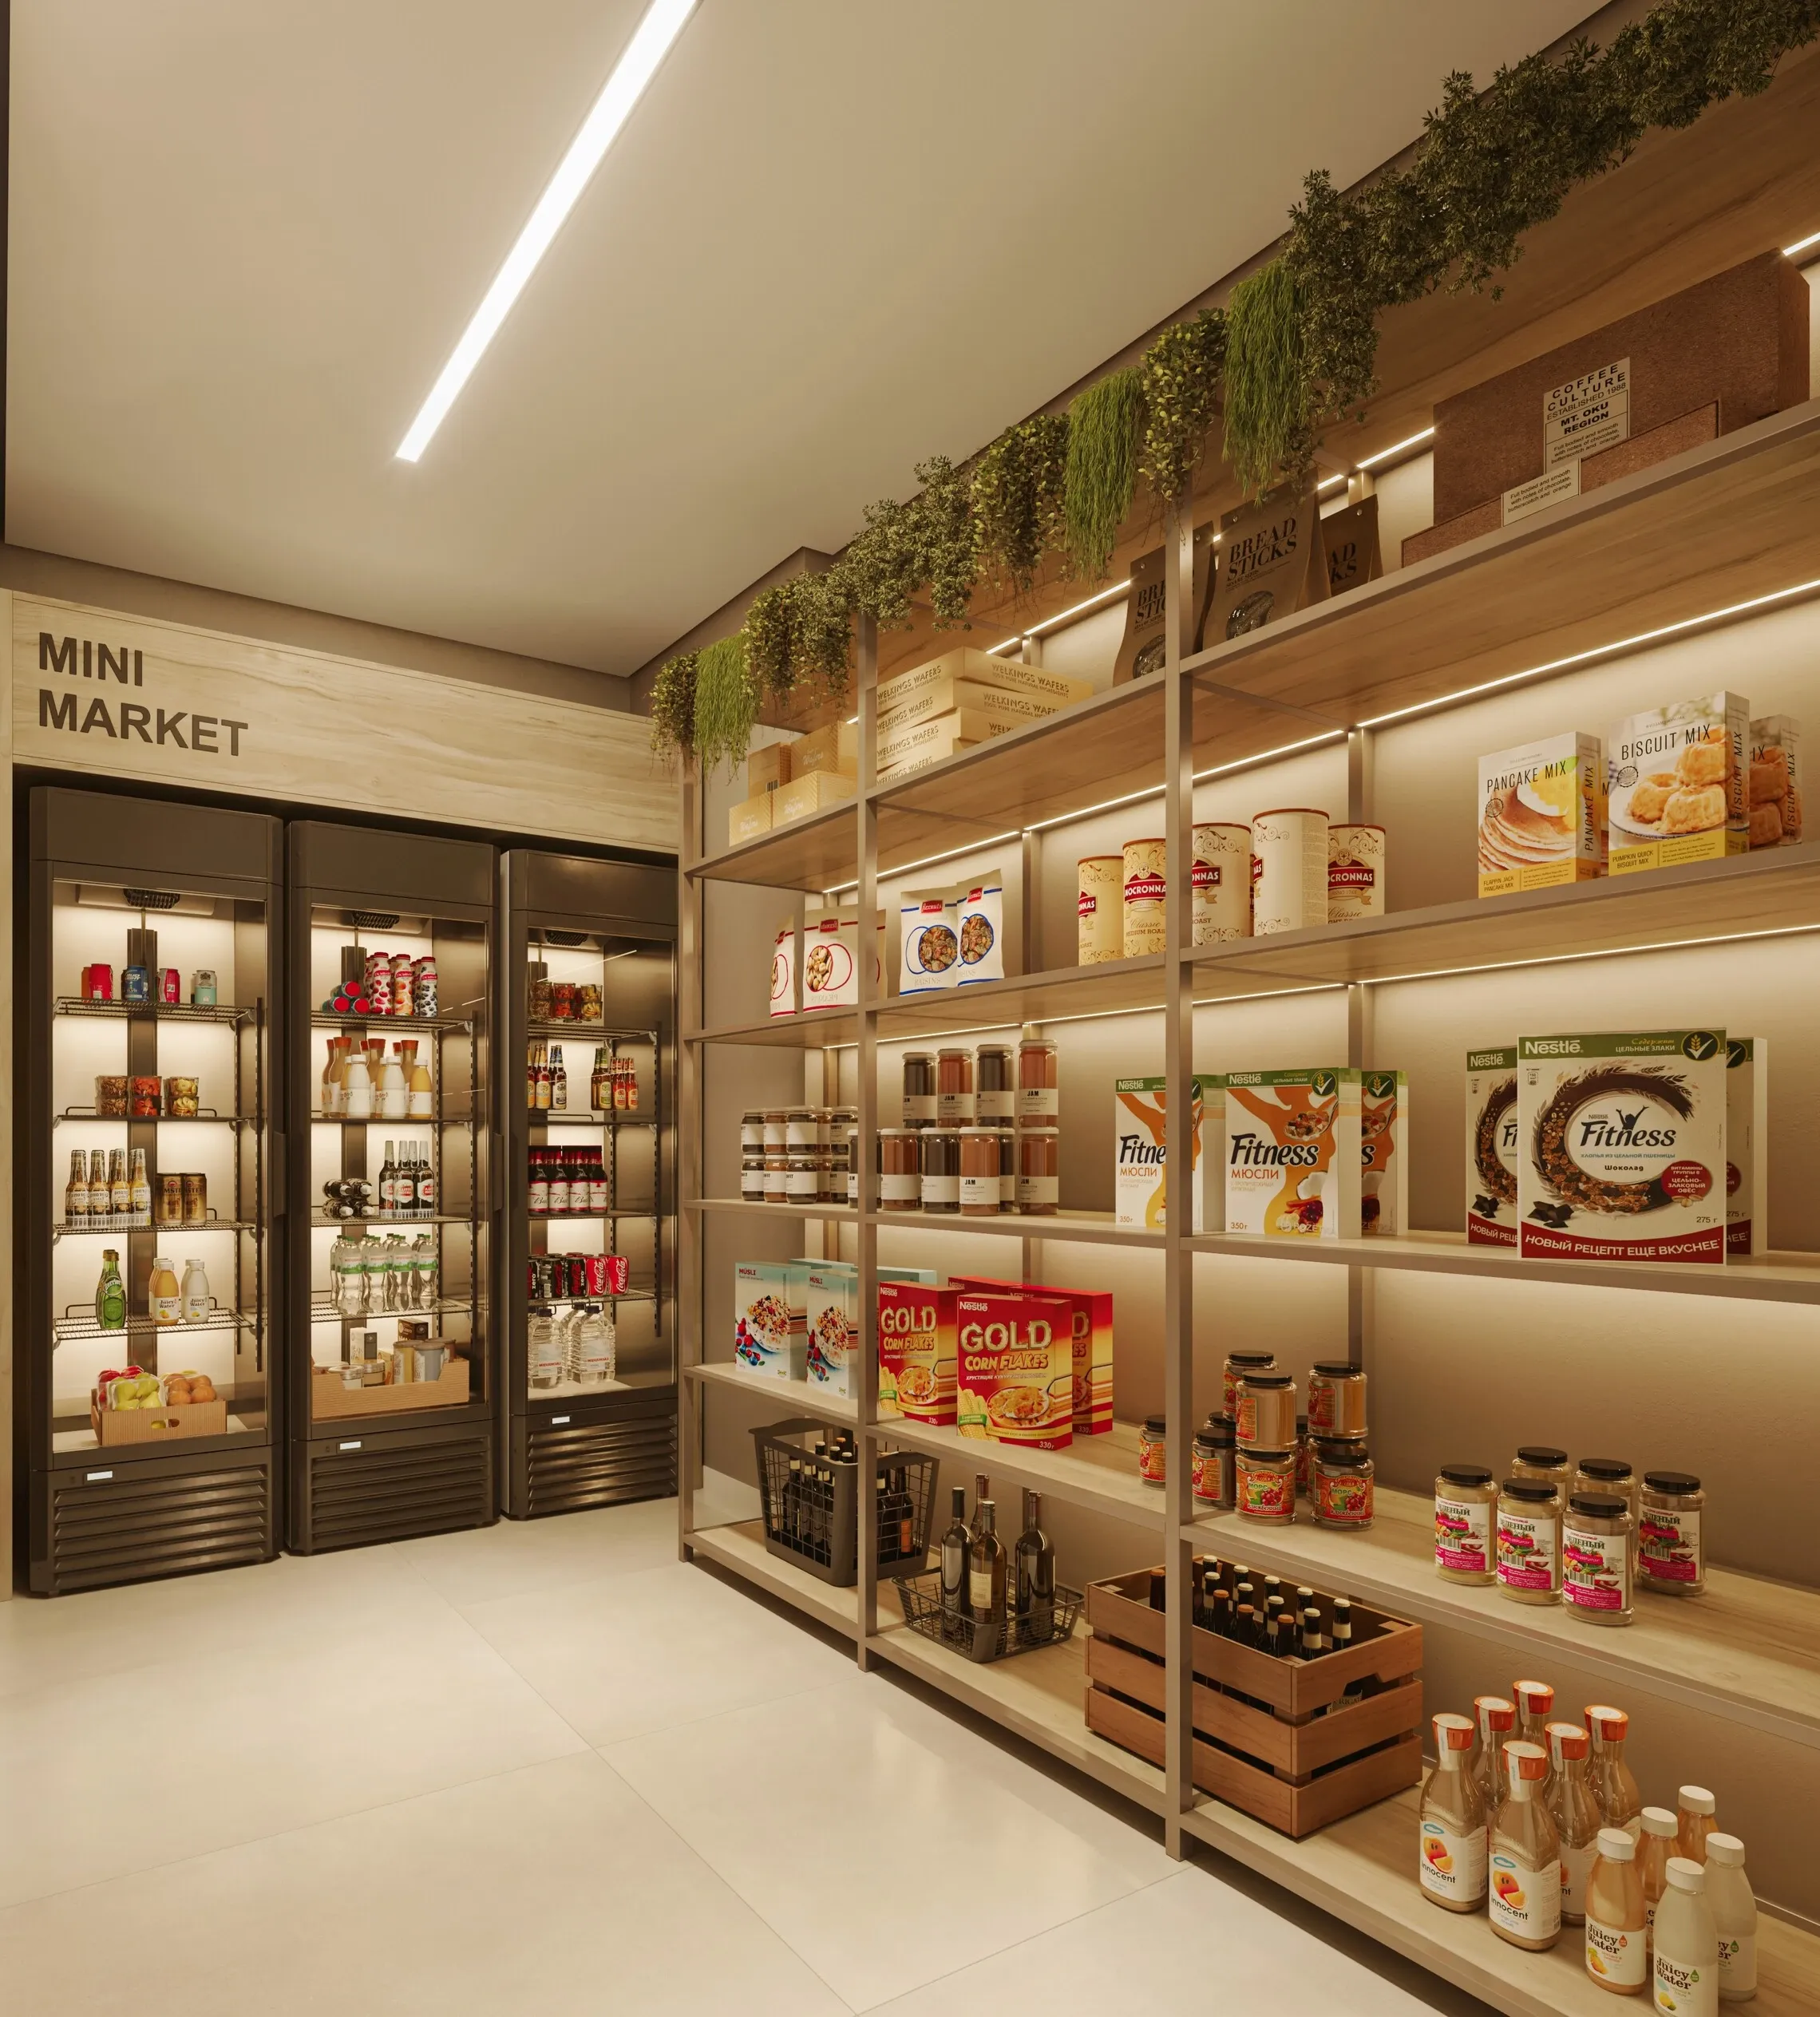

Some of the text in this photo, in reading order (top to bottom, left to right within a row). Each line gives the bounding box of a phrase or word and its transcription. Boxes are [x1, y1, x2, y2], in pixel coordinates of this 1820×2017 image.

[1548, 372, 1625, 411] CULTURE
[1553, 364, 1618, 398] COFFEE
[1547, 382, 1626, 420] ESTABLISHED 1988
[1561, 401, 1608, 426] MT. OKU
[1565, 411, 1609, 435] REGION
[1228, 517, 1297, 564] BREAD
[1228, 534, 1297, 583] STICKS
[1138, 579, 1166, 607] BRE
[1136, 601, 1166, 625] STIC
[39, 631, 143, 687] MINI
[877, 666, 942, 700] WELKINGS WAFERS
[991, 663, 1070, 693] WELKINGS WAFERS
[983, 692, 1030, 710] WELKINGS
[39, 689, 248, 757] MARKET
[876, 697, 934, 731] WELKINGS WAFERS
[877, 725, 940, 757] WELKINGS WAFERS
[1621, 723, 1711, 761] BISCUIT MIX
[1734, 732, 1743, 757] MIX
[1487, 760, 1567, 793] PANCAKE MIX
[1786, 753, 1796, 777] MIX
[1585, 765, 1594, 852] PANCAKE MIX
[1193, 872, 1219, 882] ONNAS
[1327, 872, 1373, 883] CRONNAS
[1125, 884, 1166, 896] OCRONNA
[1580, 1120, 1676, 1147] Fitness
[1119, 1134, 1166, 1165] Fitne
[1230, 1133, 1319, 1166] Fitness
[1119, 1167, 1157, 1177] МЮСЛИ
[1231, 1169, 1279, 1179] МЮСЛИ
[1470, 1223, 1498, 1238] НОВЫЙ
[1525, 1233, 1573, 1251] НОВЫЙ
[1574, 1244, 1625, 1258] РЕЦЕПТ
[1627, 1244, 1656, 1258] ЕЩЕ
[809, 1275, 823, 1284] MÜSLI
[880, 1306, 936, 1335] GOLD
[883, 1335, 935, 1351] CORN FLAKES
[960, 1319, 1052, 1353] GOLD
[964, 1353, 1048, 1372] CORN FLAKES
[1248, 1482, 1268, 1491] МОРС
[1421, 1861, 1456, 1884] innocent
[1490, 1895, 1529, 1920] innocent
[1587, 1923, 1618, 1946] Juicy
[1587, 1932, 1620, 1955] Water
[1656, 1956, 1690, 1981] Juicy
[1656, 1965, 1691, 1990] Water
